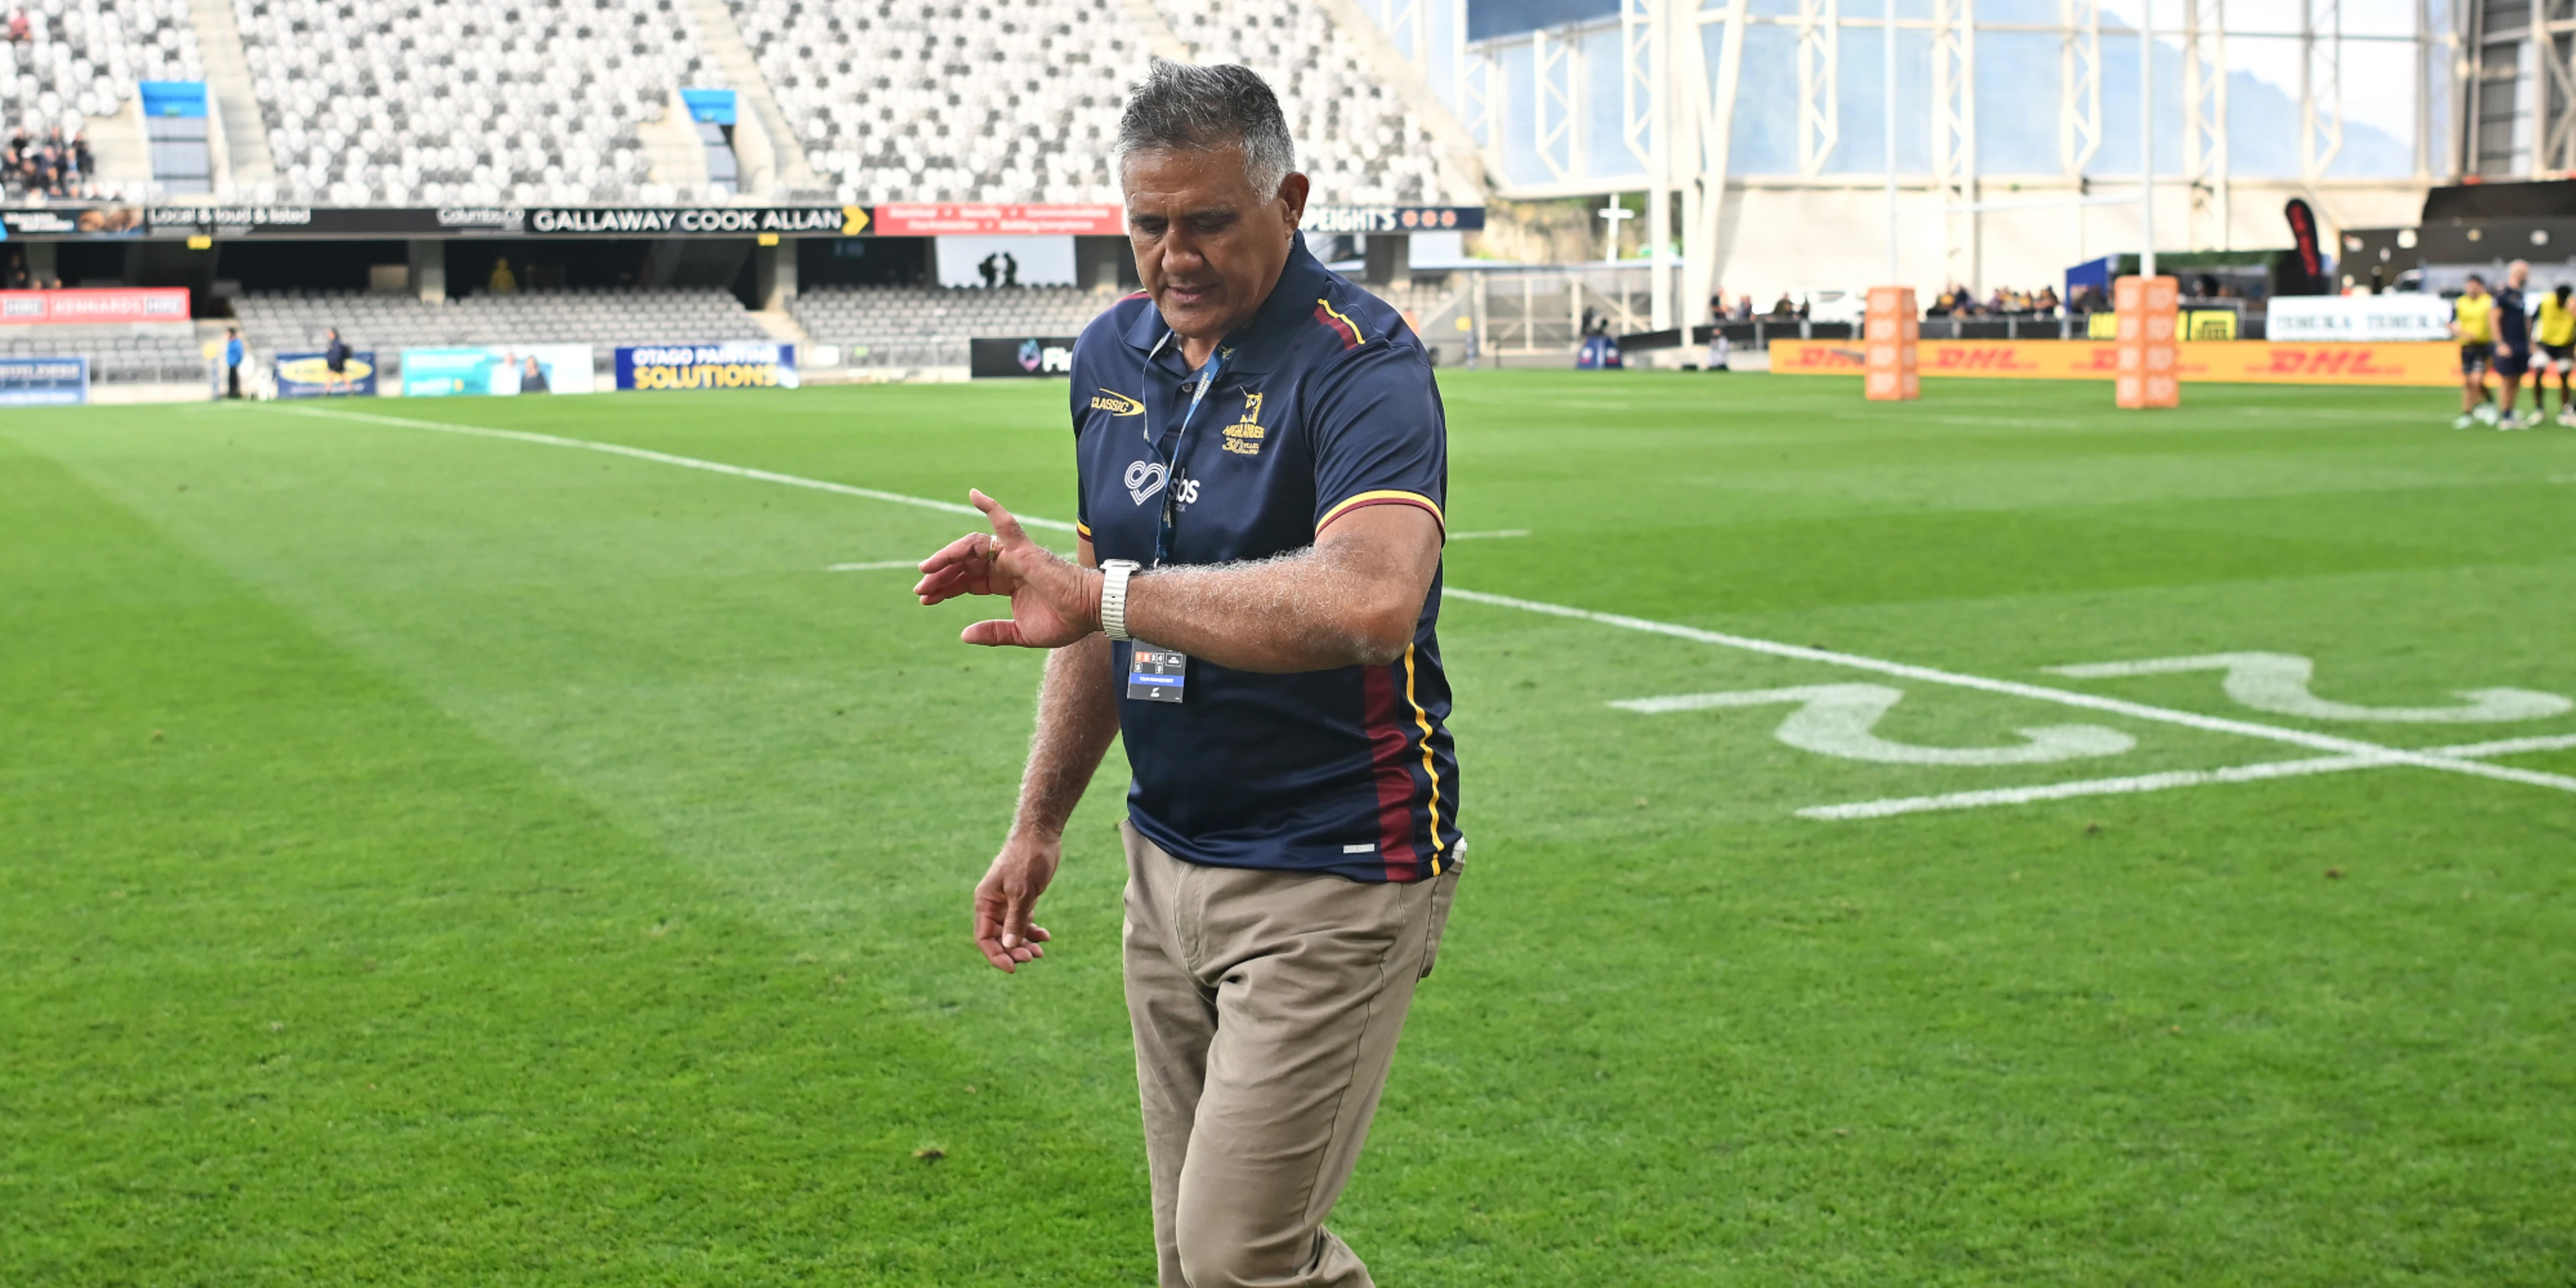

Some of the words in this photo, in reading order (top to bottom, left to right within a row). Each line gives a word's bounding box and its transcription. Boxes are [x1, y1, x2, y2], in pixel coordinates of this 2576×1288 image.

[149, 207, 195, 225] Local
[197, 207, 211, 225] &
[254, 207, 267, 225] &
[533, 209, 675, 231] GALLAWAY
[680, 209, 757, 231] COOK
[761, 210, 842, 230] ALLAN
[633, 348, 694, 365] OTAGO
[1935, 347, 2021, 370] DHL
[2269, 350, 2379, 374] DHL
[634, 364, 778, 389] SOLUTIONS
[1091, 396, 1129, 413] CLASSIC
